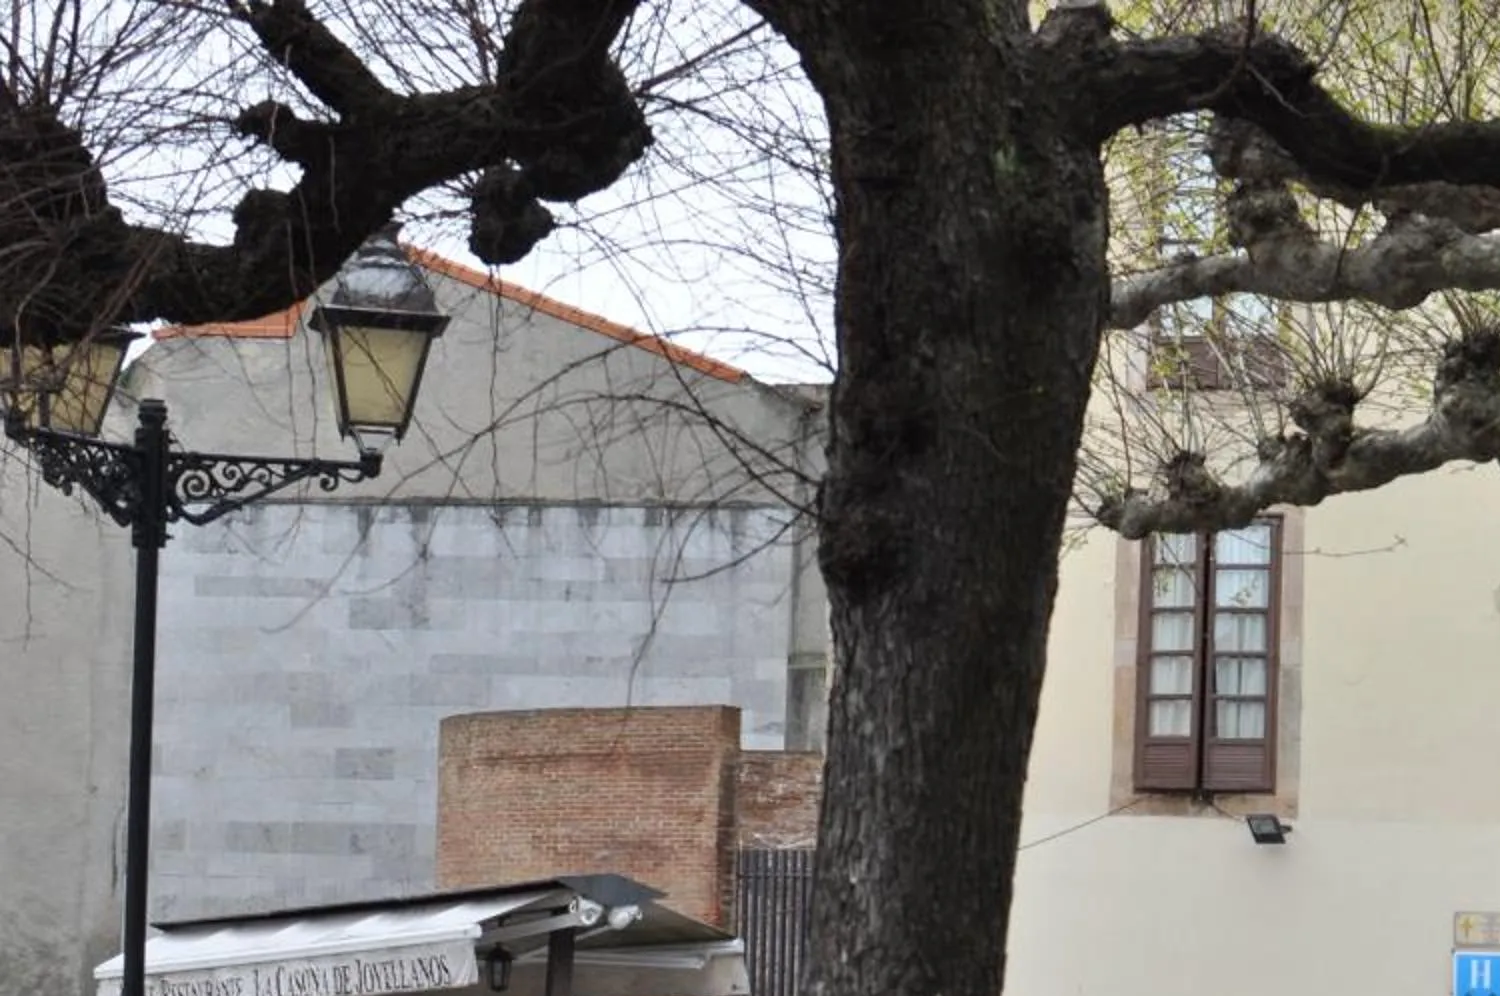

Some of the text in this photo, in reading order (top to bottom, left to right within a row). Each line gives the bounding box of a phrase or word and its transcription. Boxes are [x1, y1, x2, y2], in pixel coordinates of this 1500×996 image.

[333, 965, 351, 996] DE
[354, 954, 450, 994] JOVELLANOS
[1470, 959, 1492, 989] H
